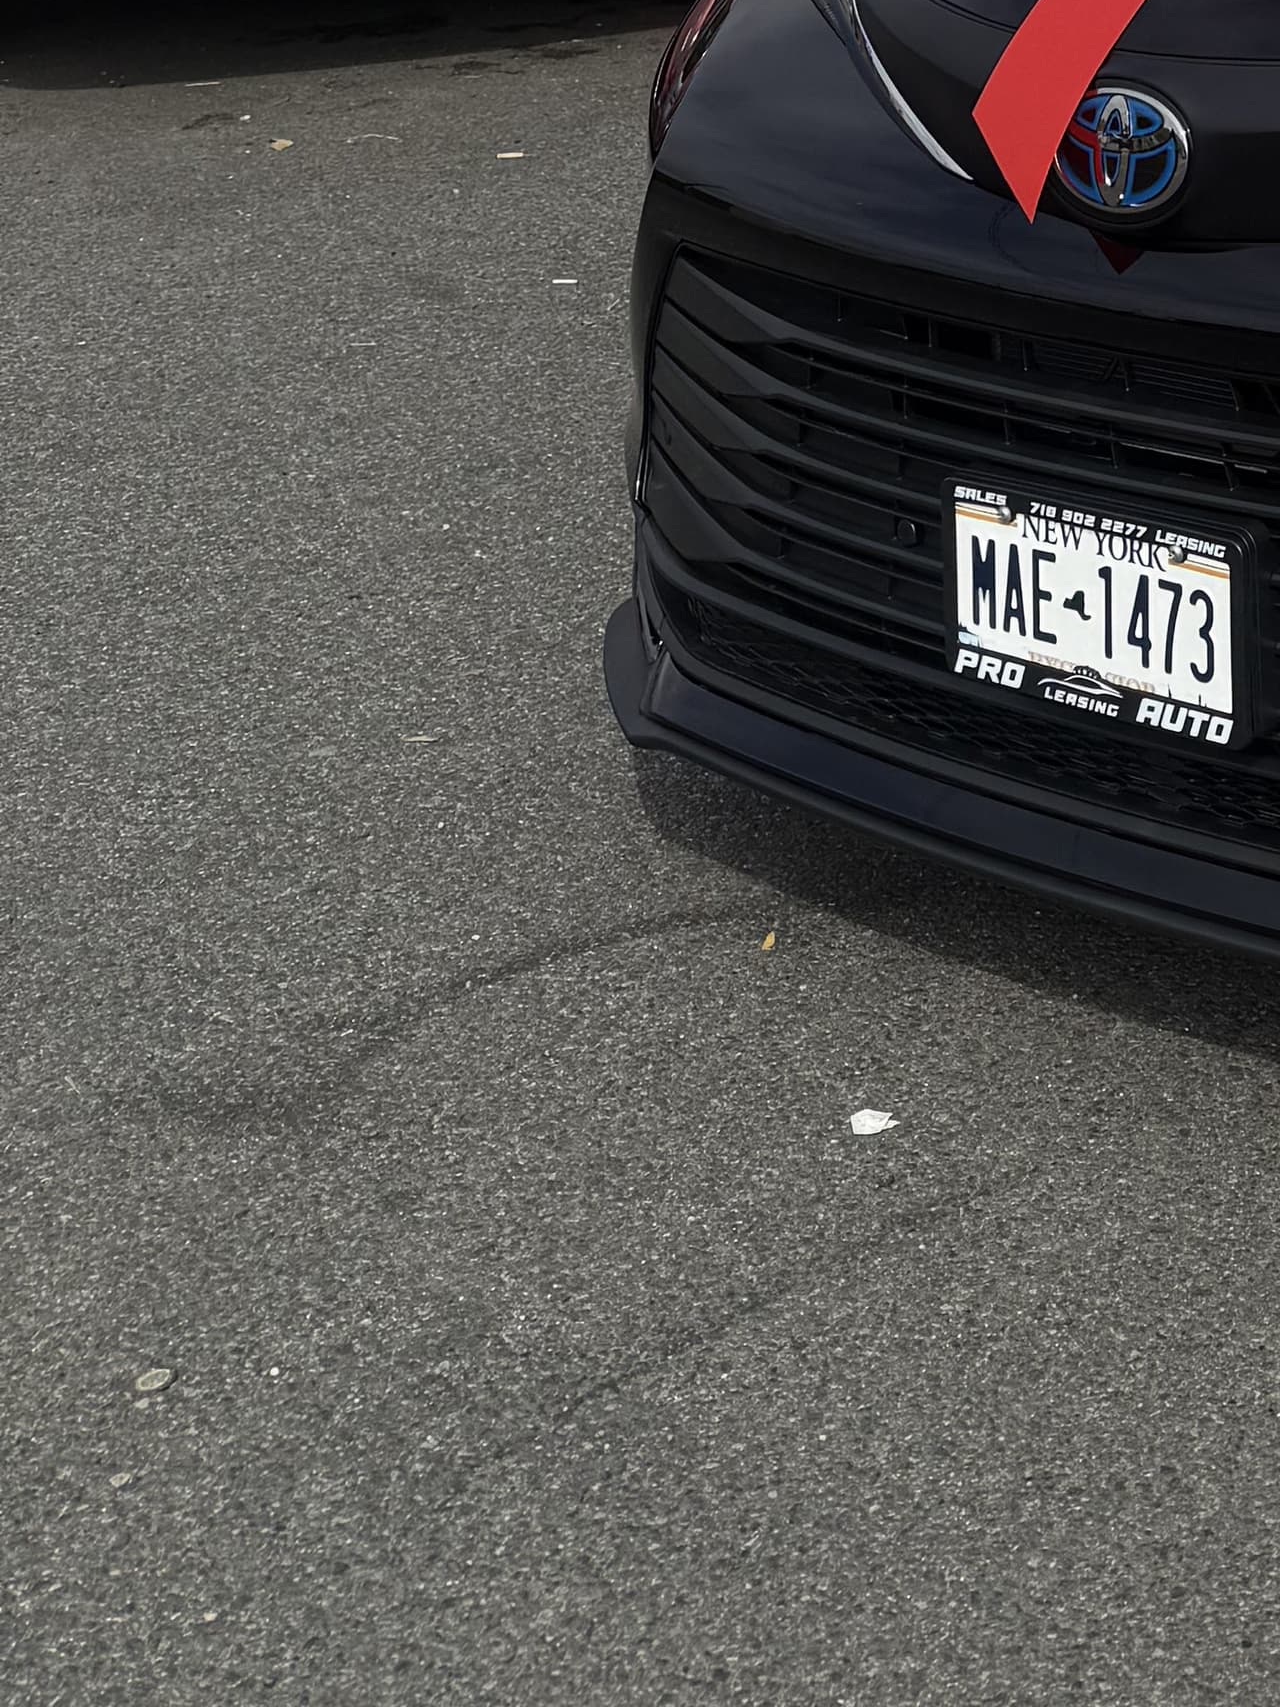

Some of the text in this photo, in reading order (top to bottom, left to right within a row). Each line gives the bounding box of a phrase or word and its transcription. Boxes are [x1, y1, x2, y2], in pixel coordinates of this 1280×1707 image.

[954, 486, 1226, 558] SALES 718 902 2277 LEASING
[1022, 516, 1166, 572] NEW YORK
[971, 535, 1214, 683] MAE 1473
[954, 648, 1026, 689] PRO
[1044, 687, 1120, 717] LEASING
[1136, 698, 1234, 745] AUTO
